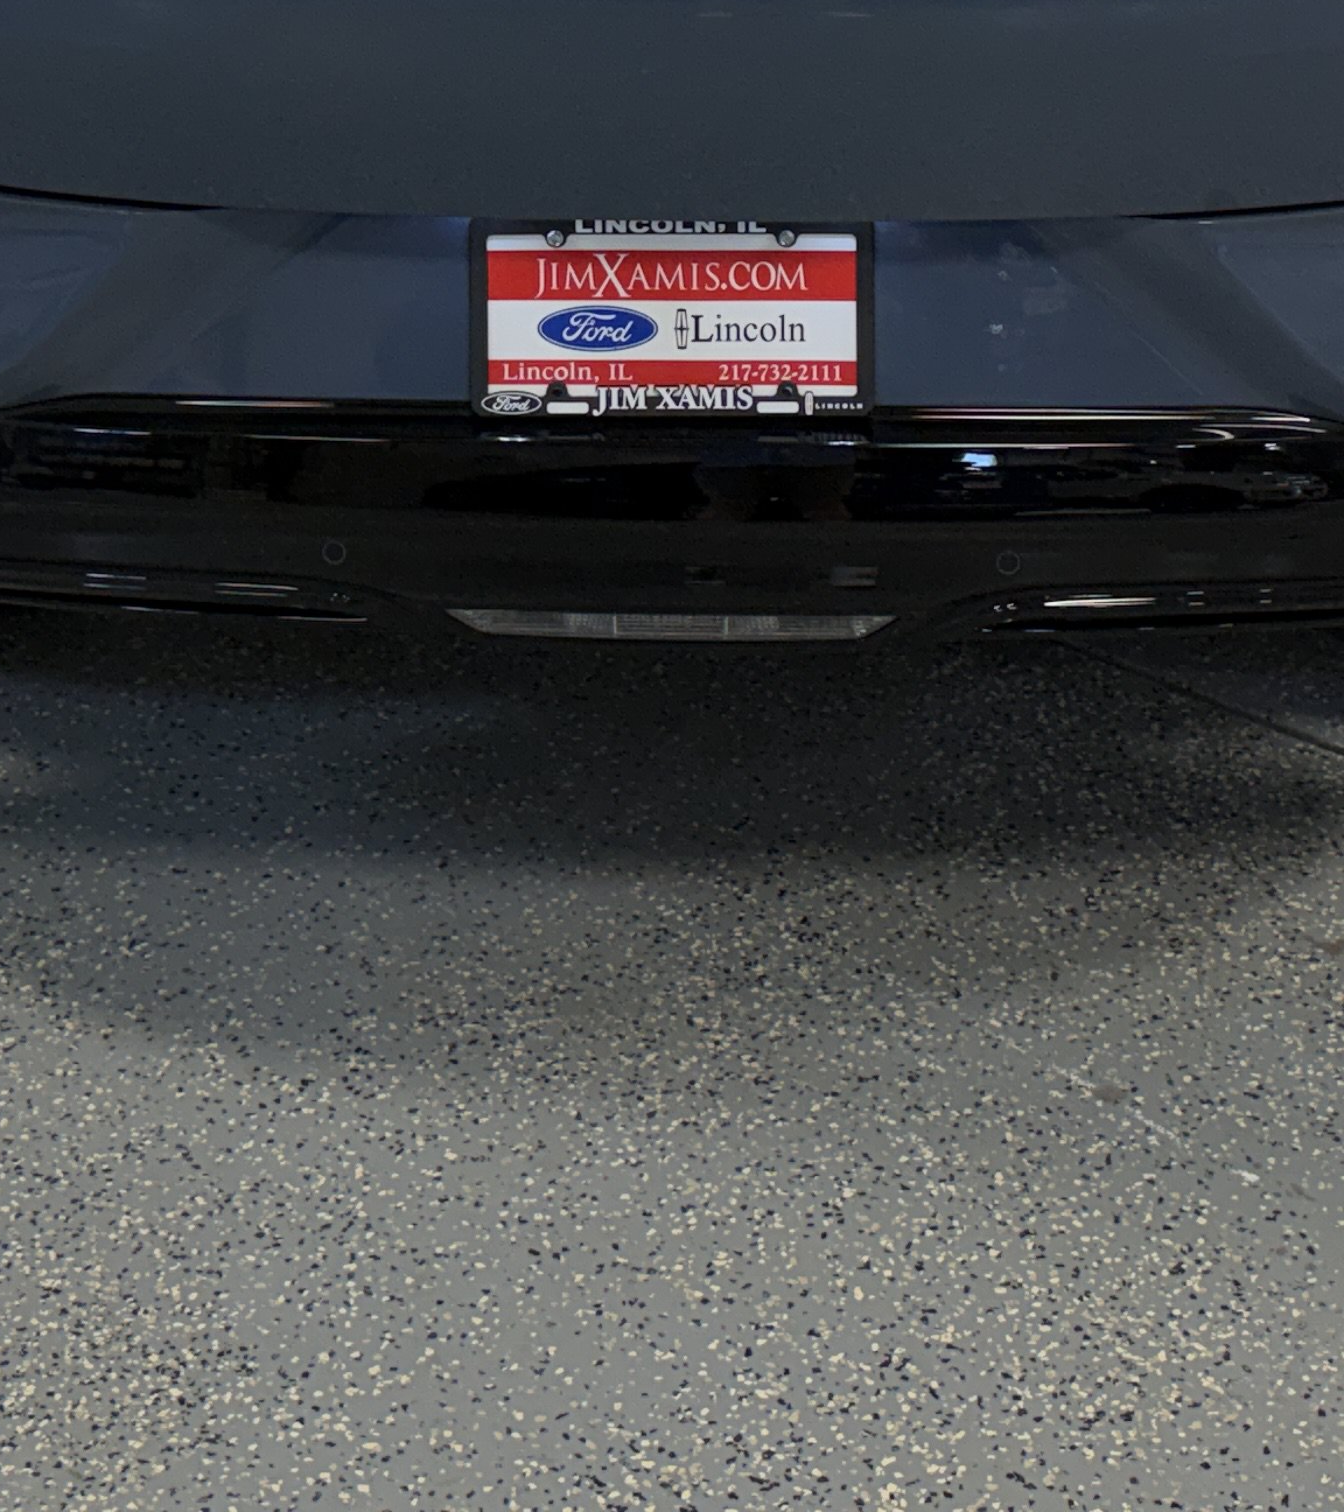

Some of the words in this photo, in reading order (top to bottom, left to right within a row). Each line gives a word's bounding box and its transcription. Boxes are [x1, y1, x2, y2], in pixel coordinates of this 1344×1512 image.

[575, 219, 727, 233] LINCOLN,
[737, 220, 767, 234] IL
[534, 252, 808, 299] JIMXAMIS.COM
[561, 311, 634, 343] Ford
[691, 314, 806, 343] Lincoln
[503, 362, 600, 382] Lincoln,
[608, 363, 633, 381] IL
[718, 364, 843, 382] 217-732-2111
[592, 385, 648, 417] JIM
[656, 385, 754, 410] XAMIS
[815, 402, 863, 410] LINCOLN
